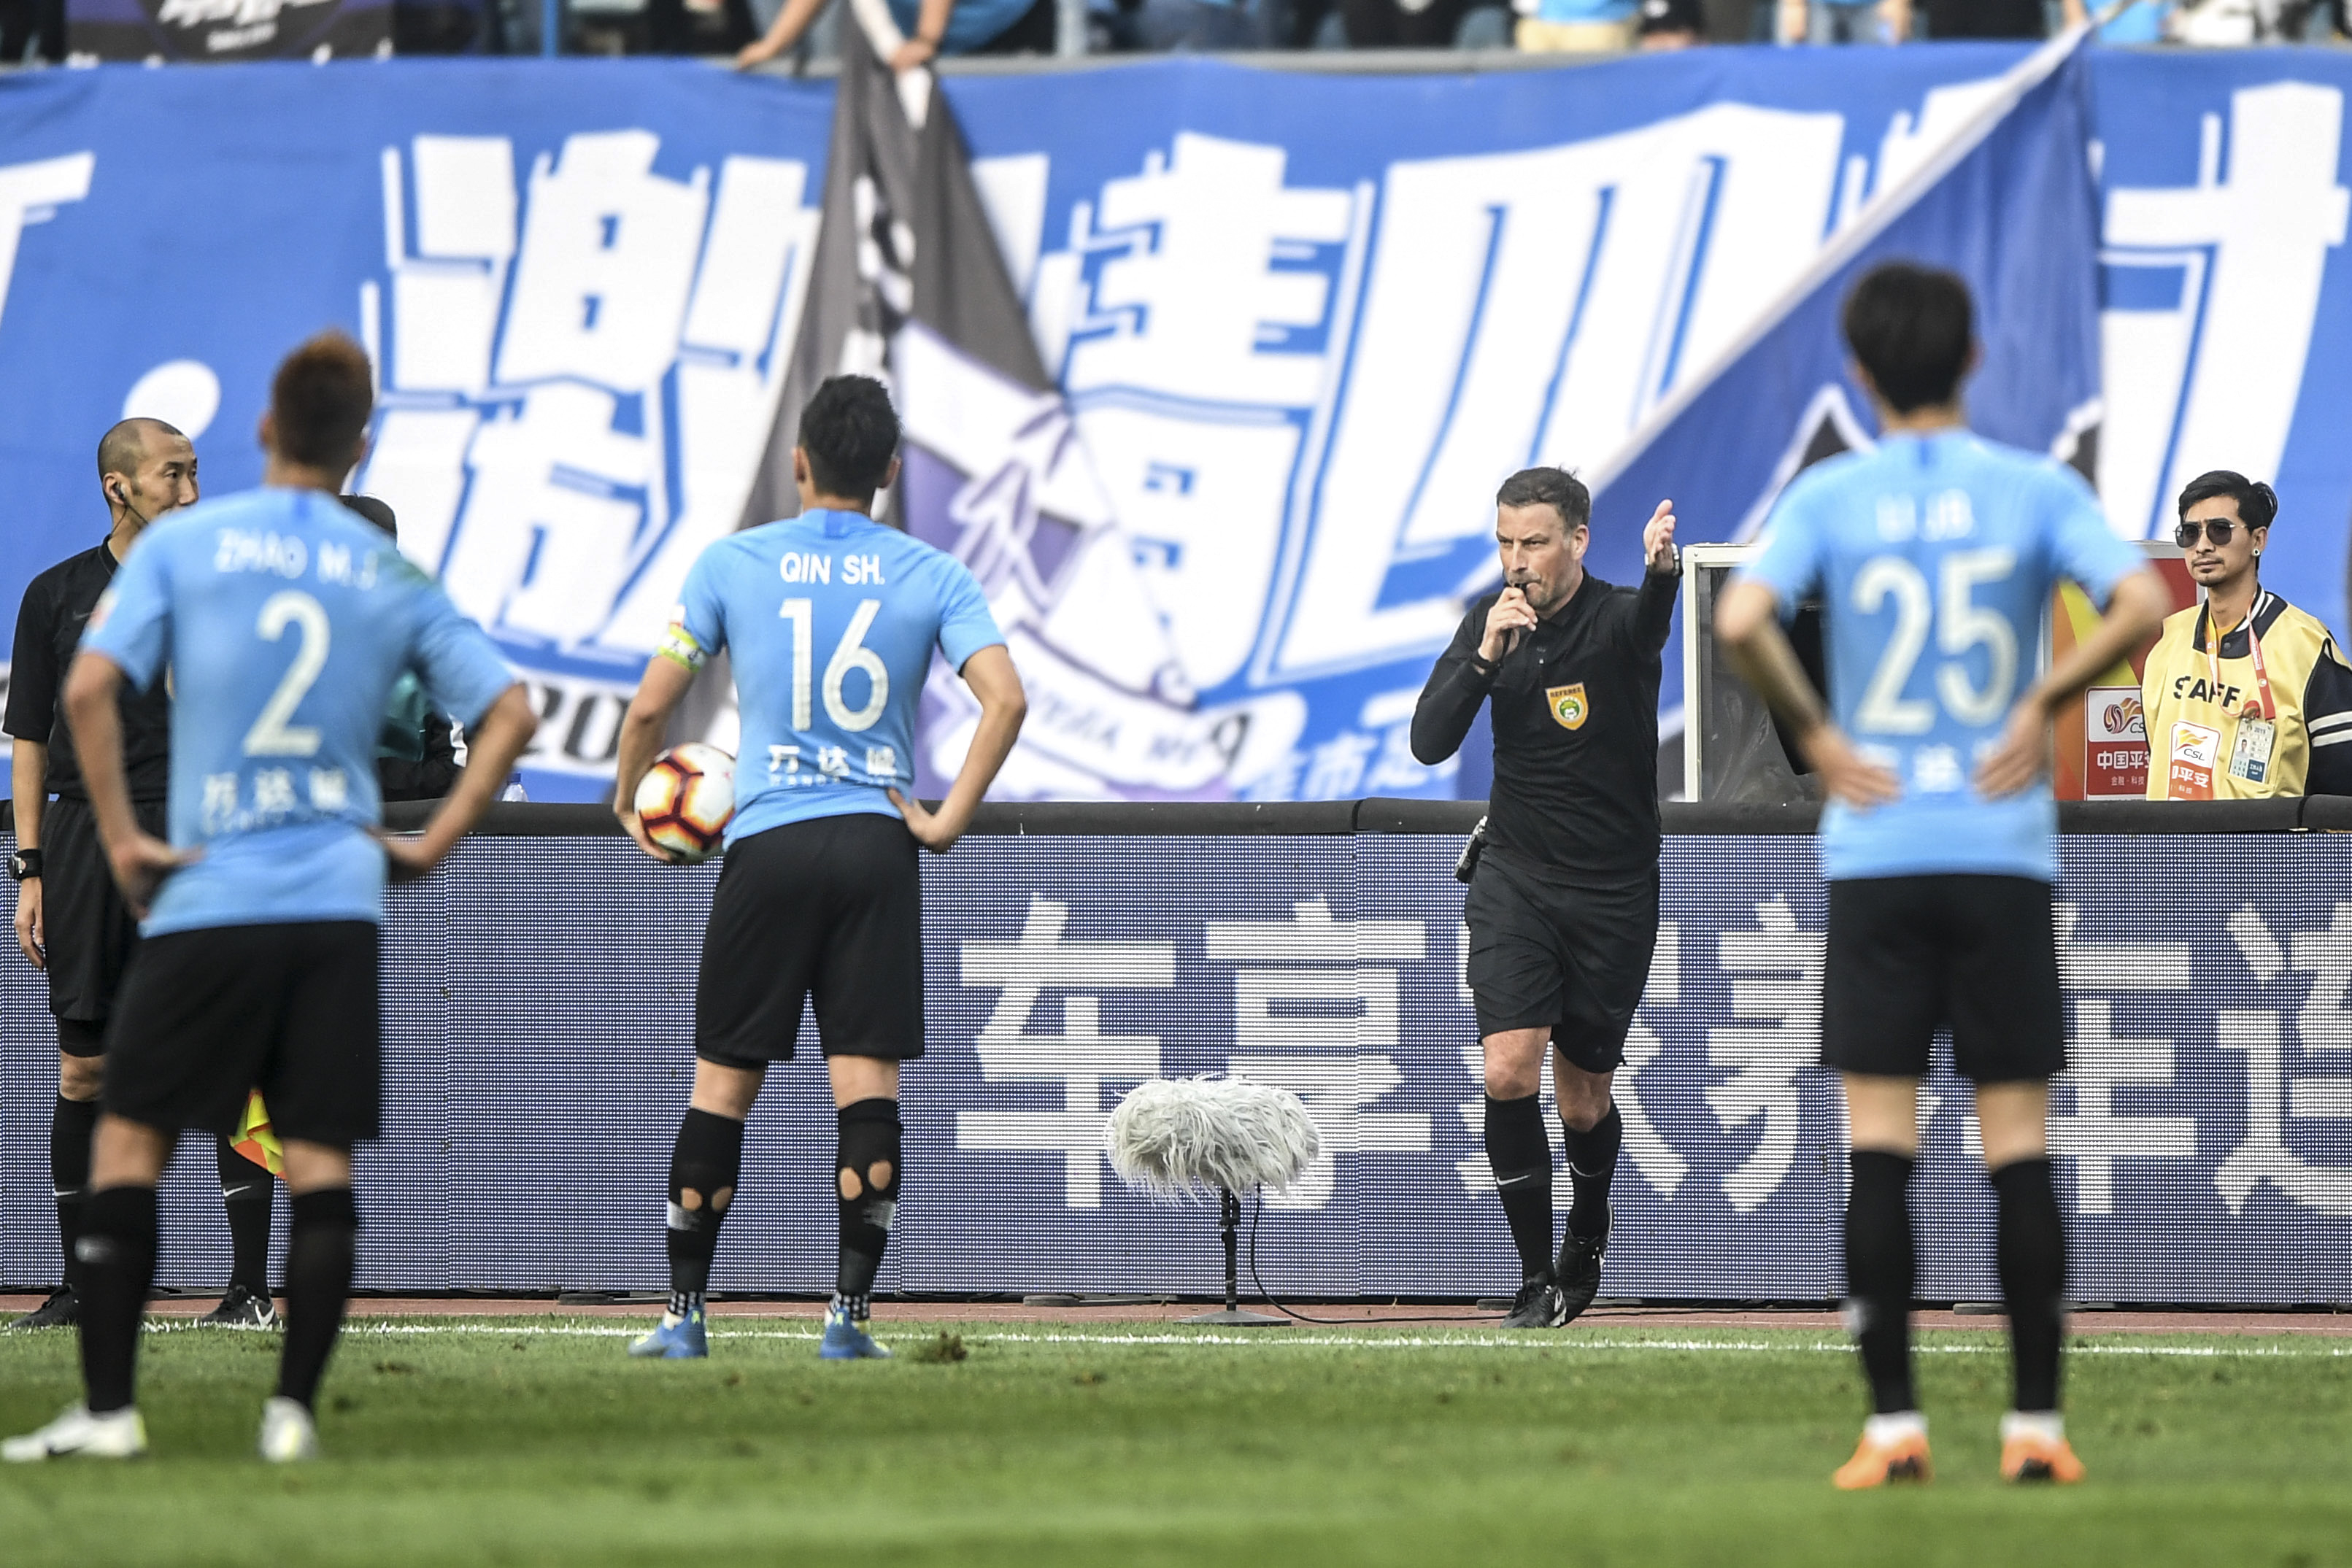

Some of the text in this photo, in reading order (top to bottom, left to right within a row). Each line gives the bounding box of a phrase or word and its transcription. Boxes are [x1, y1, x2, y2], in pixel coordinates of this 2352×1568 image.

[780, 552, 830, 584] QIN
[243, 590, 331, 757] 2
[779, 598, 890, 733] 16
[1849, 545, 2019, 735] 25
[2129, 722, 2145, 734] CS
[2183, 748, 2206, 761] CSL
